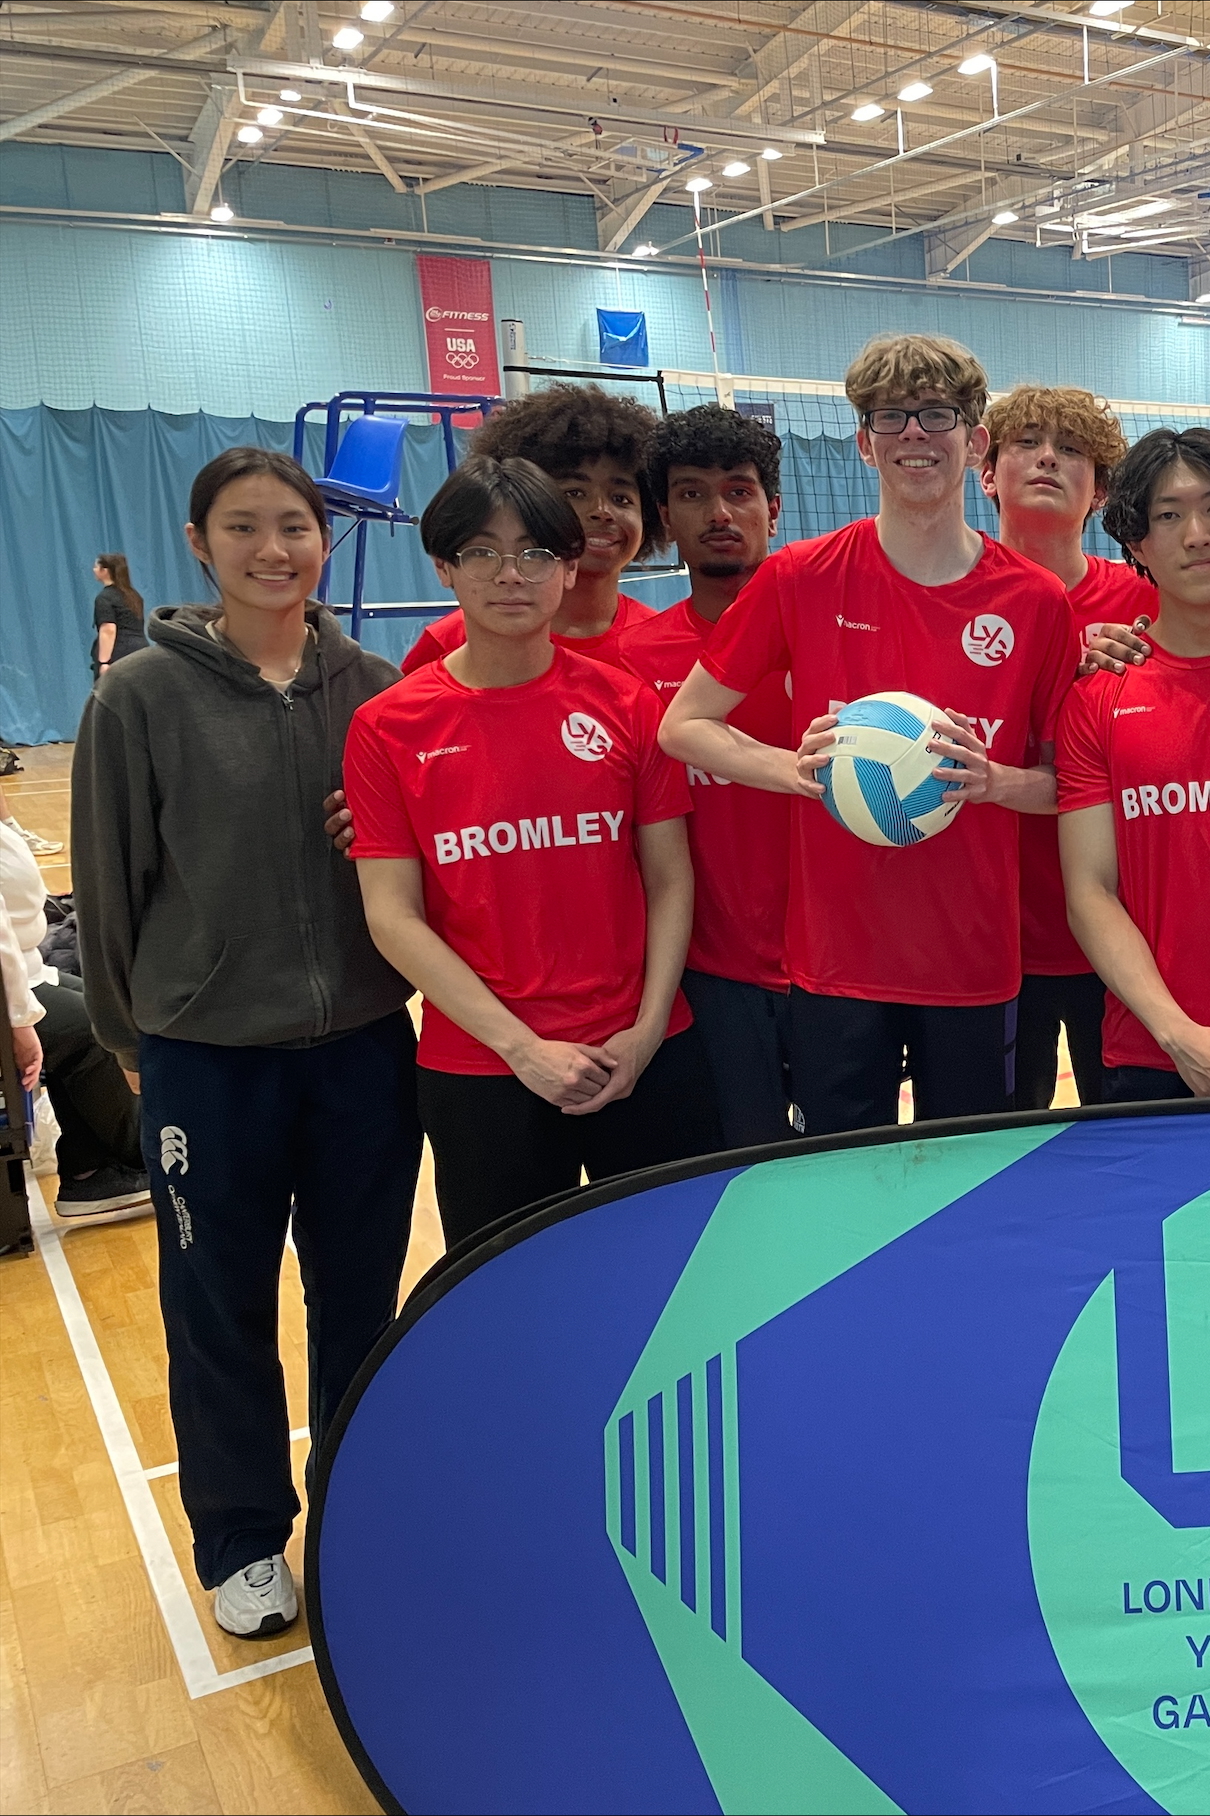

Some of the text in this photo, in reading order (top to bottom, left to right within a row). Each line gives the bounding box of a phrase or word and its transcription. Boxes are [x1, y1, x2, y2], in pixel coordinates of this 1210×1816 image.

[442, 310, 489, 321] FITNESS
[446, 337, 476, 353] USA
[427, 745, 460, 759] macron
[433, 810, 625, 865] BROMLEY
